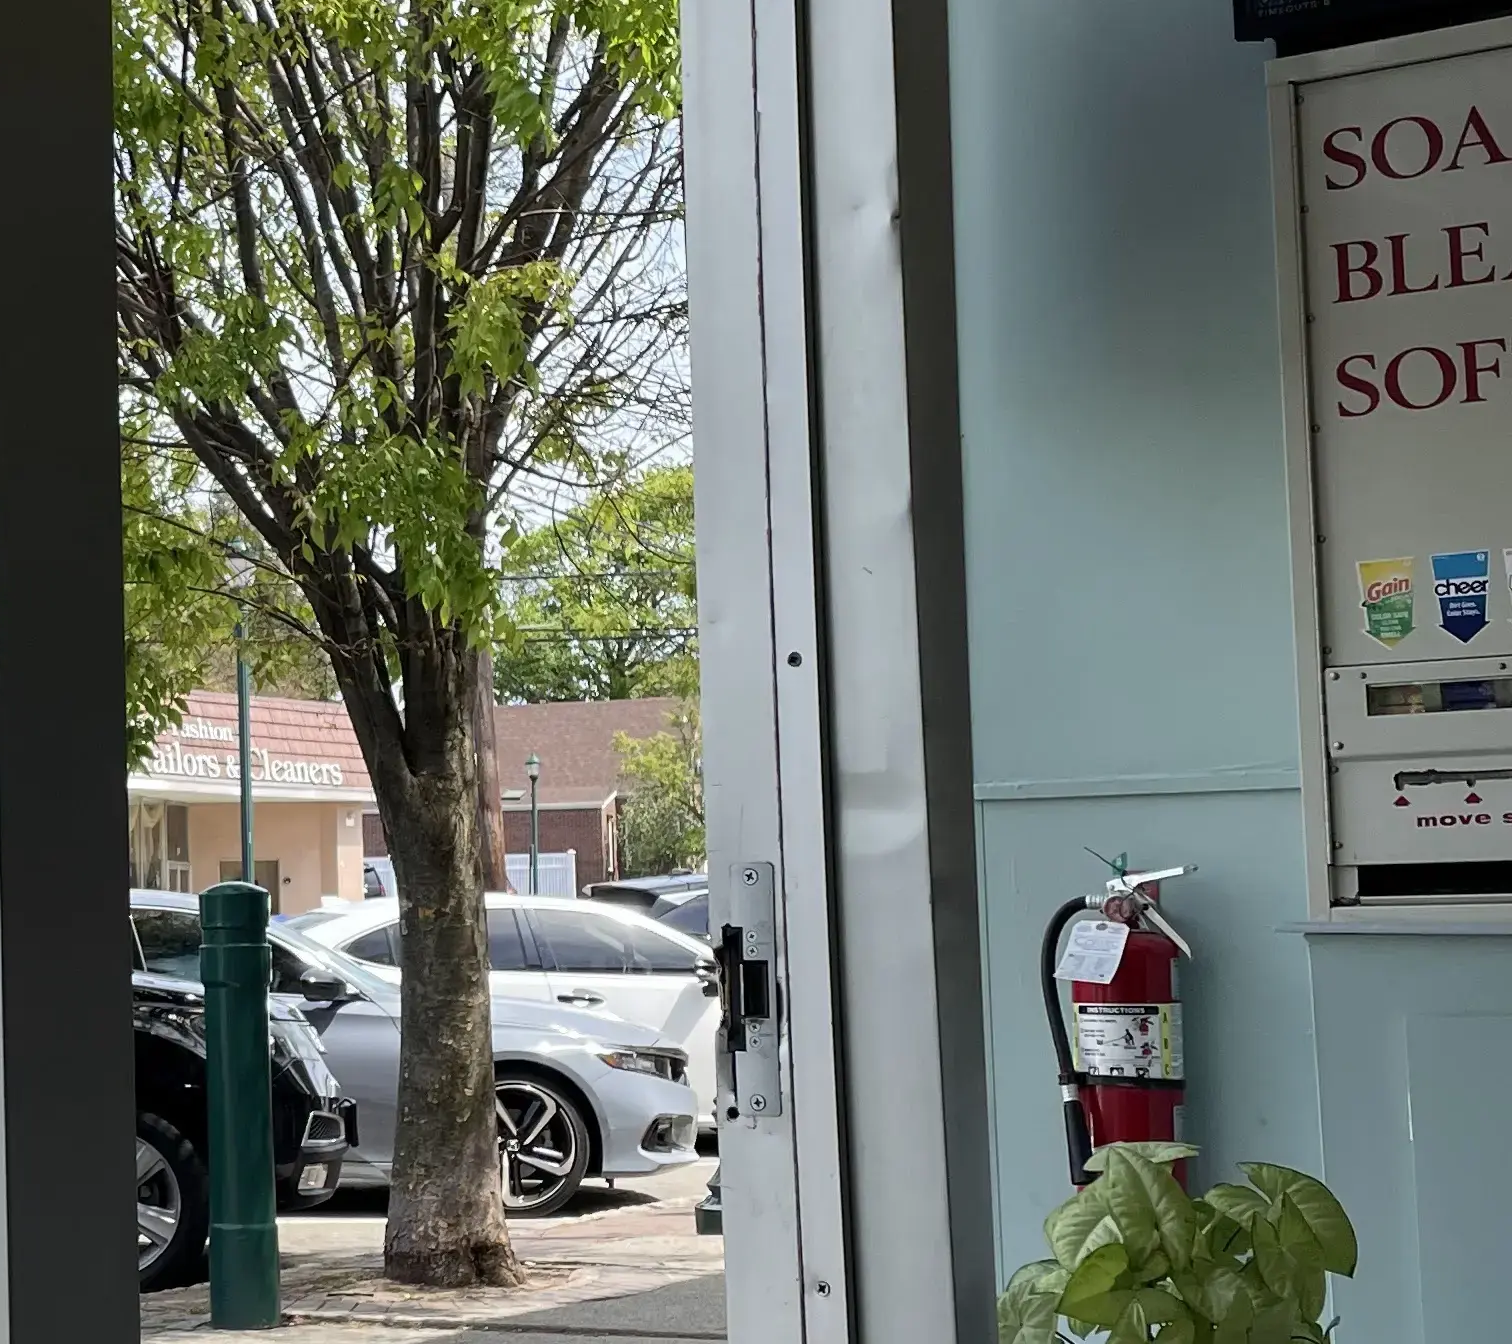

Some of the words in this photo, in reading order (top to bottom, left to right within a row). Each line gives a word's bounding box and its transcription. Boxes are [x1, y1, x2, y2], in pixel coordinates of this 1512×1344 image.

[1323, 104, 1512, 191] SOA
[1329, 221, 1512, 304] BLE
[1368, 577, 1410, 601] Gain
[1434, 578, 1489, 597] cheer
[1416, 813, 1491, 828] move
